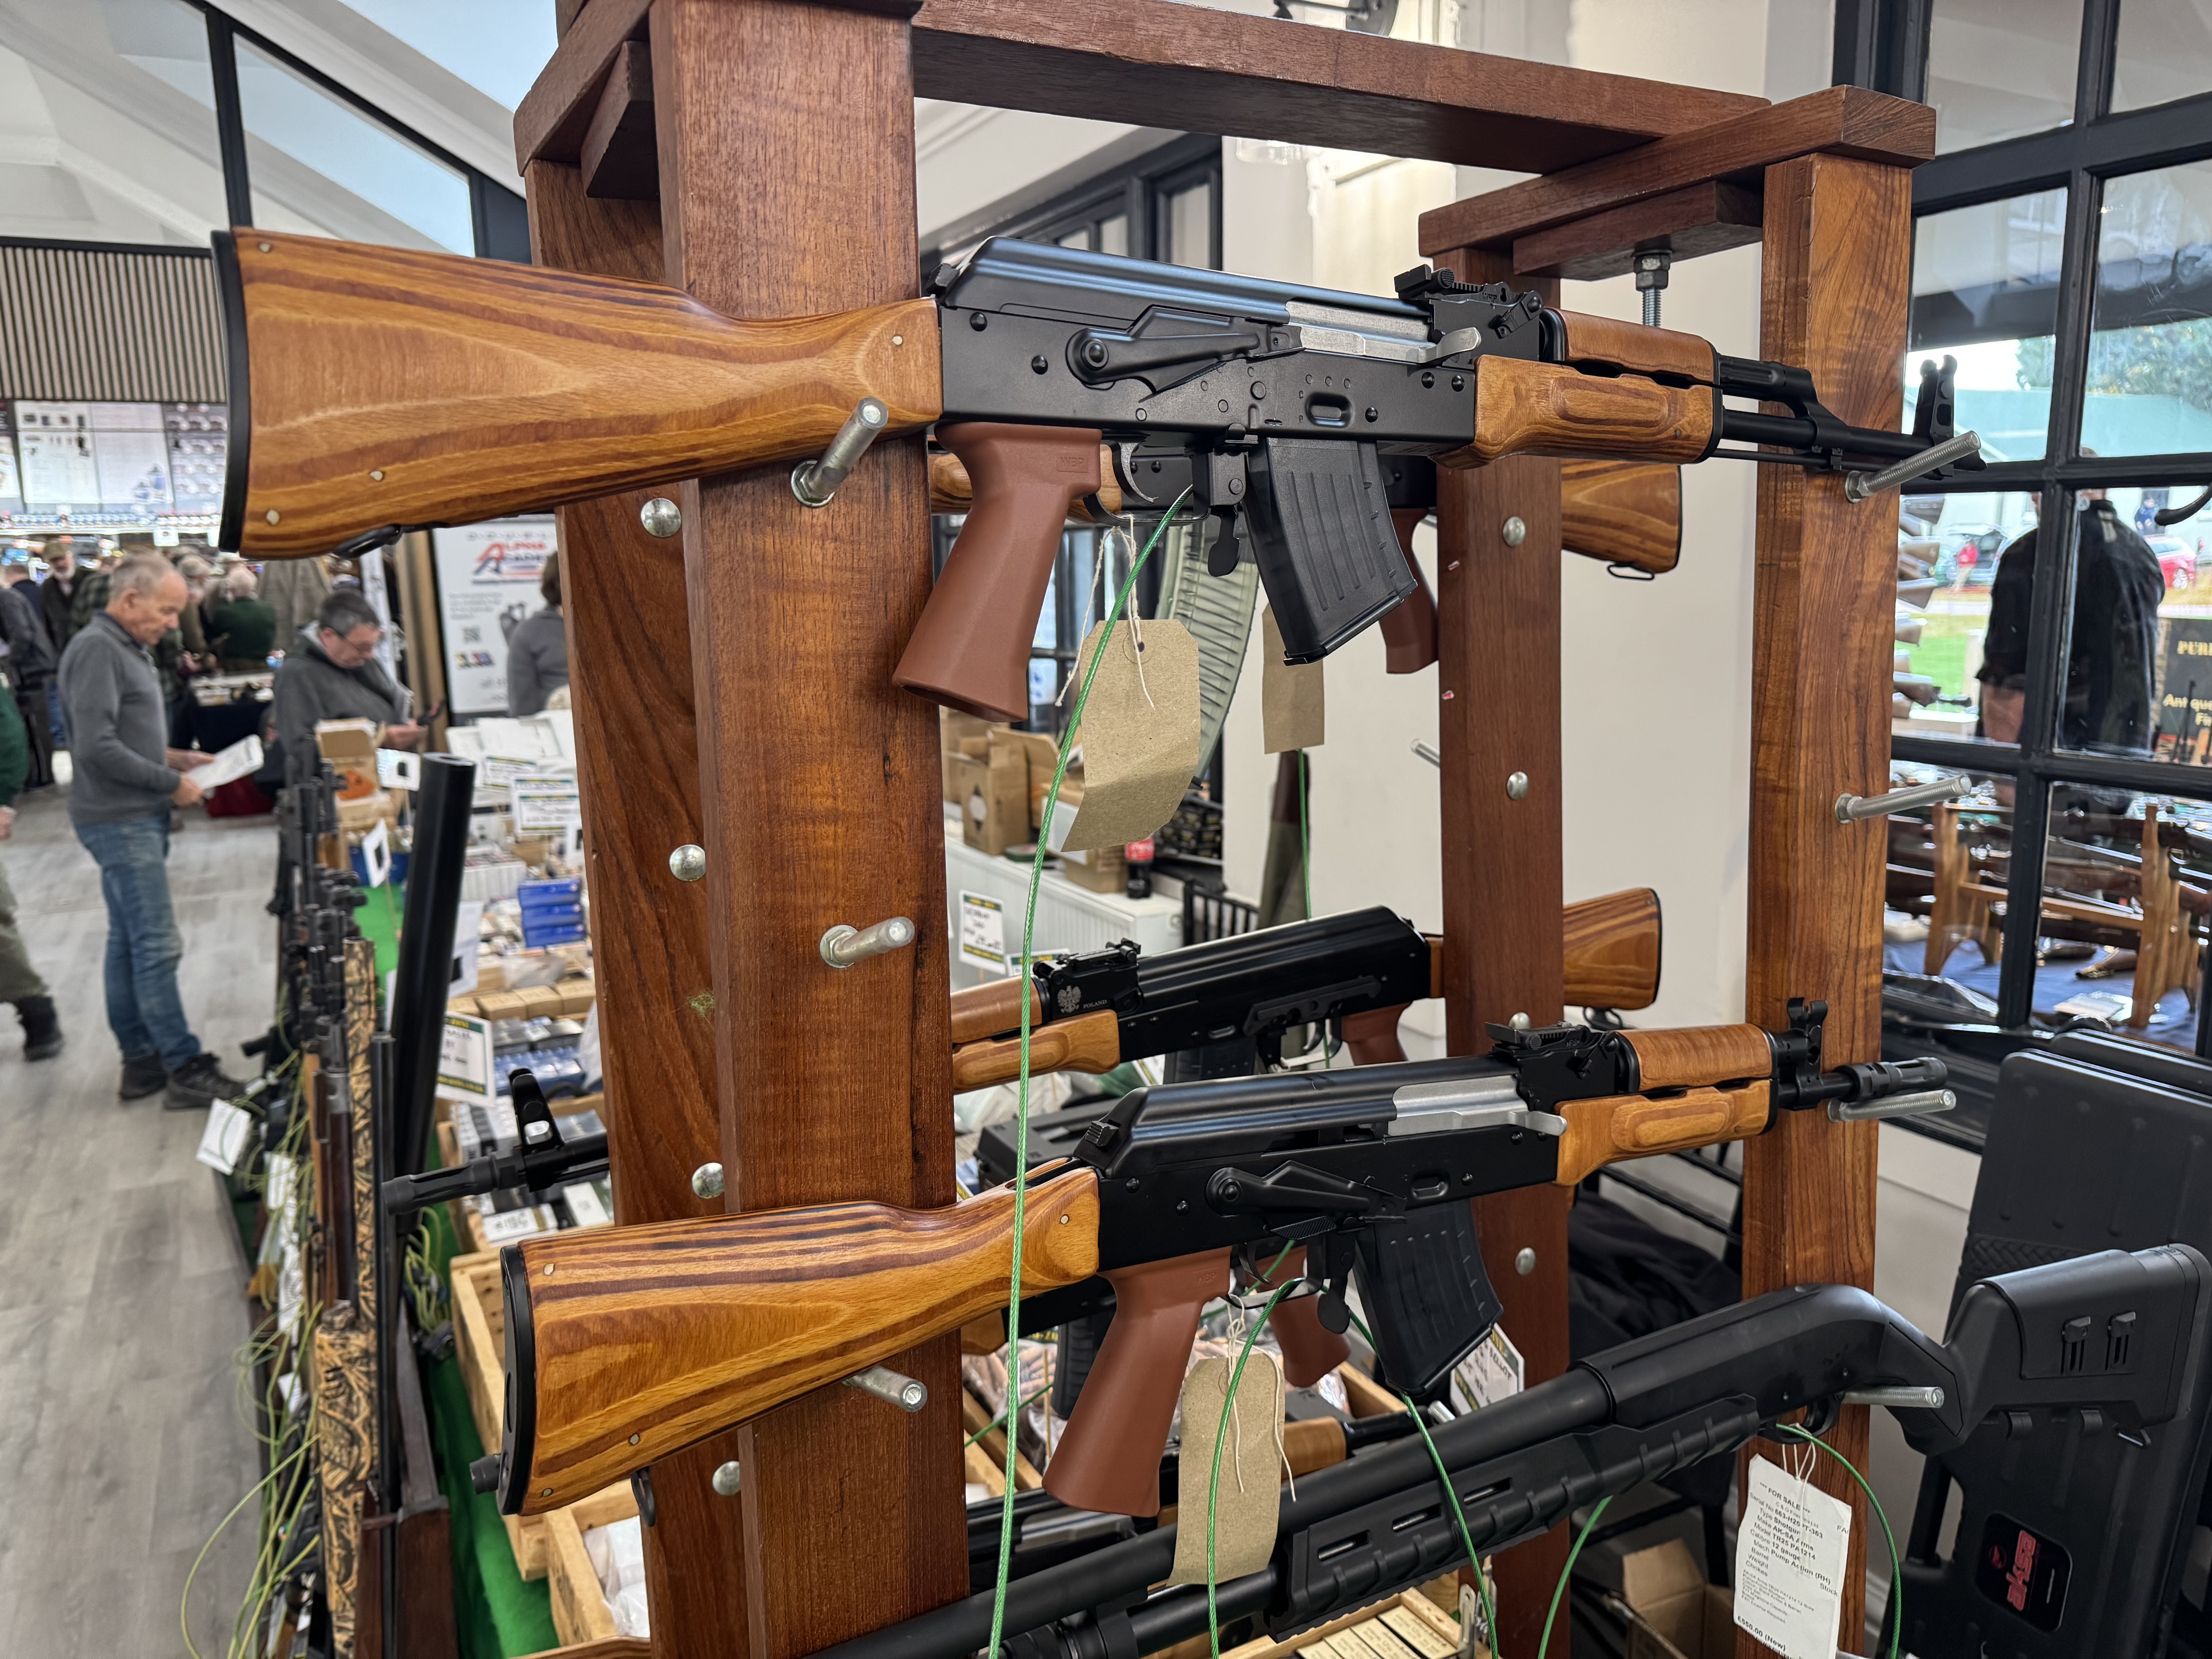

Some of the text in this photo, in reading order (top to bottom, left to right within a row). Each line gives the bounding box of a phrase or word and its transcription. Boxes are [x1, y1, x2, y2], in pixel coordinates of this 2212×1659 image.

[2177, 641, 2212, 656] PUR
[1083, 1000, 1107, 1009] POLAND
[1197, 1271, 1217, 1283] WBP
[1766, 1503, 1774, 1511] No
[1769, 1487, 1800, 1511] FOR SALE
[1757, 1515, 1772, 1528] Make
[1773, 1526, 1794, 1541] AK-SA
[1760, 1508, 1800, 1534] Type Shotgun
[1750, 1529, 1770, 1544] Calibre
[1781, 1547, 1800, 1562] gauge
[1754, 1522, 1815, 1560] Model TR25 PA1214
[1746, 1560, 1767, 1577] Chokes
[1748, 1554, 1768, 1569] Weight
[1752, 1547, 1838, 1596] Barrel Stock
[1754, 1539, 1830, 1585] Mech Pump Action (RH)
[1765, 1634, 1786, 1652] (New)
